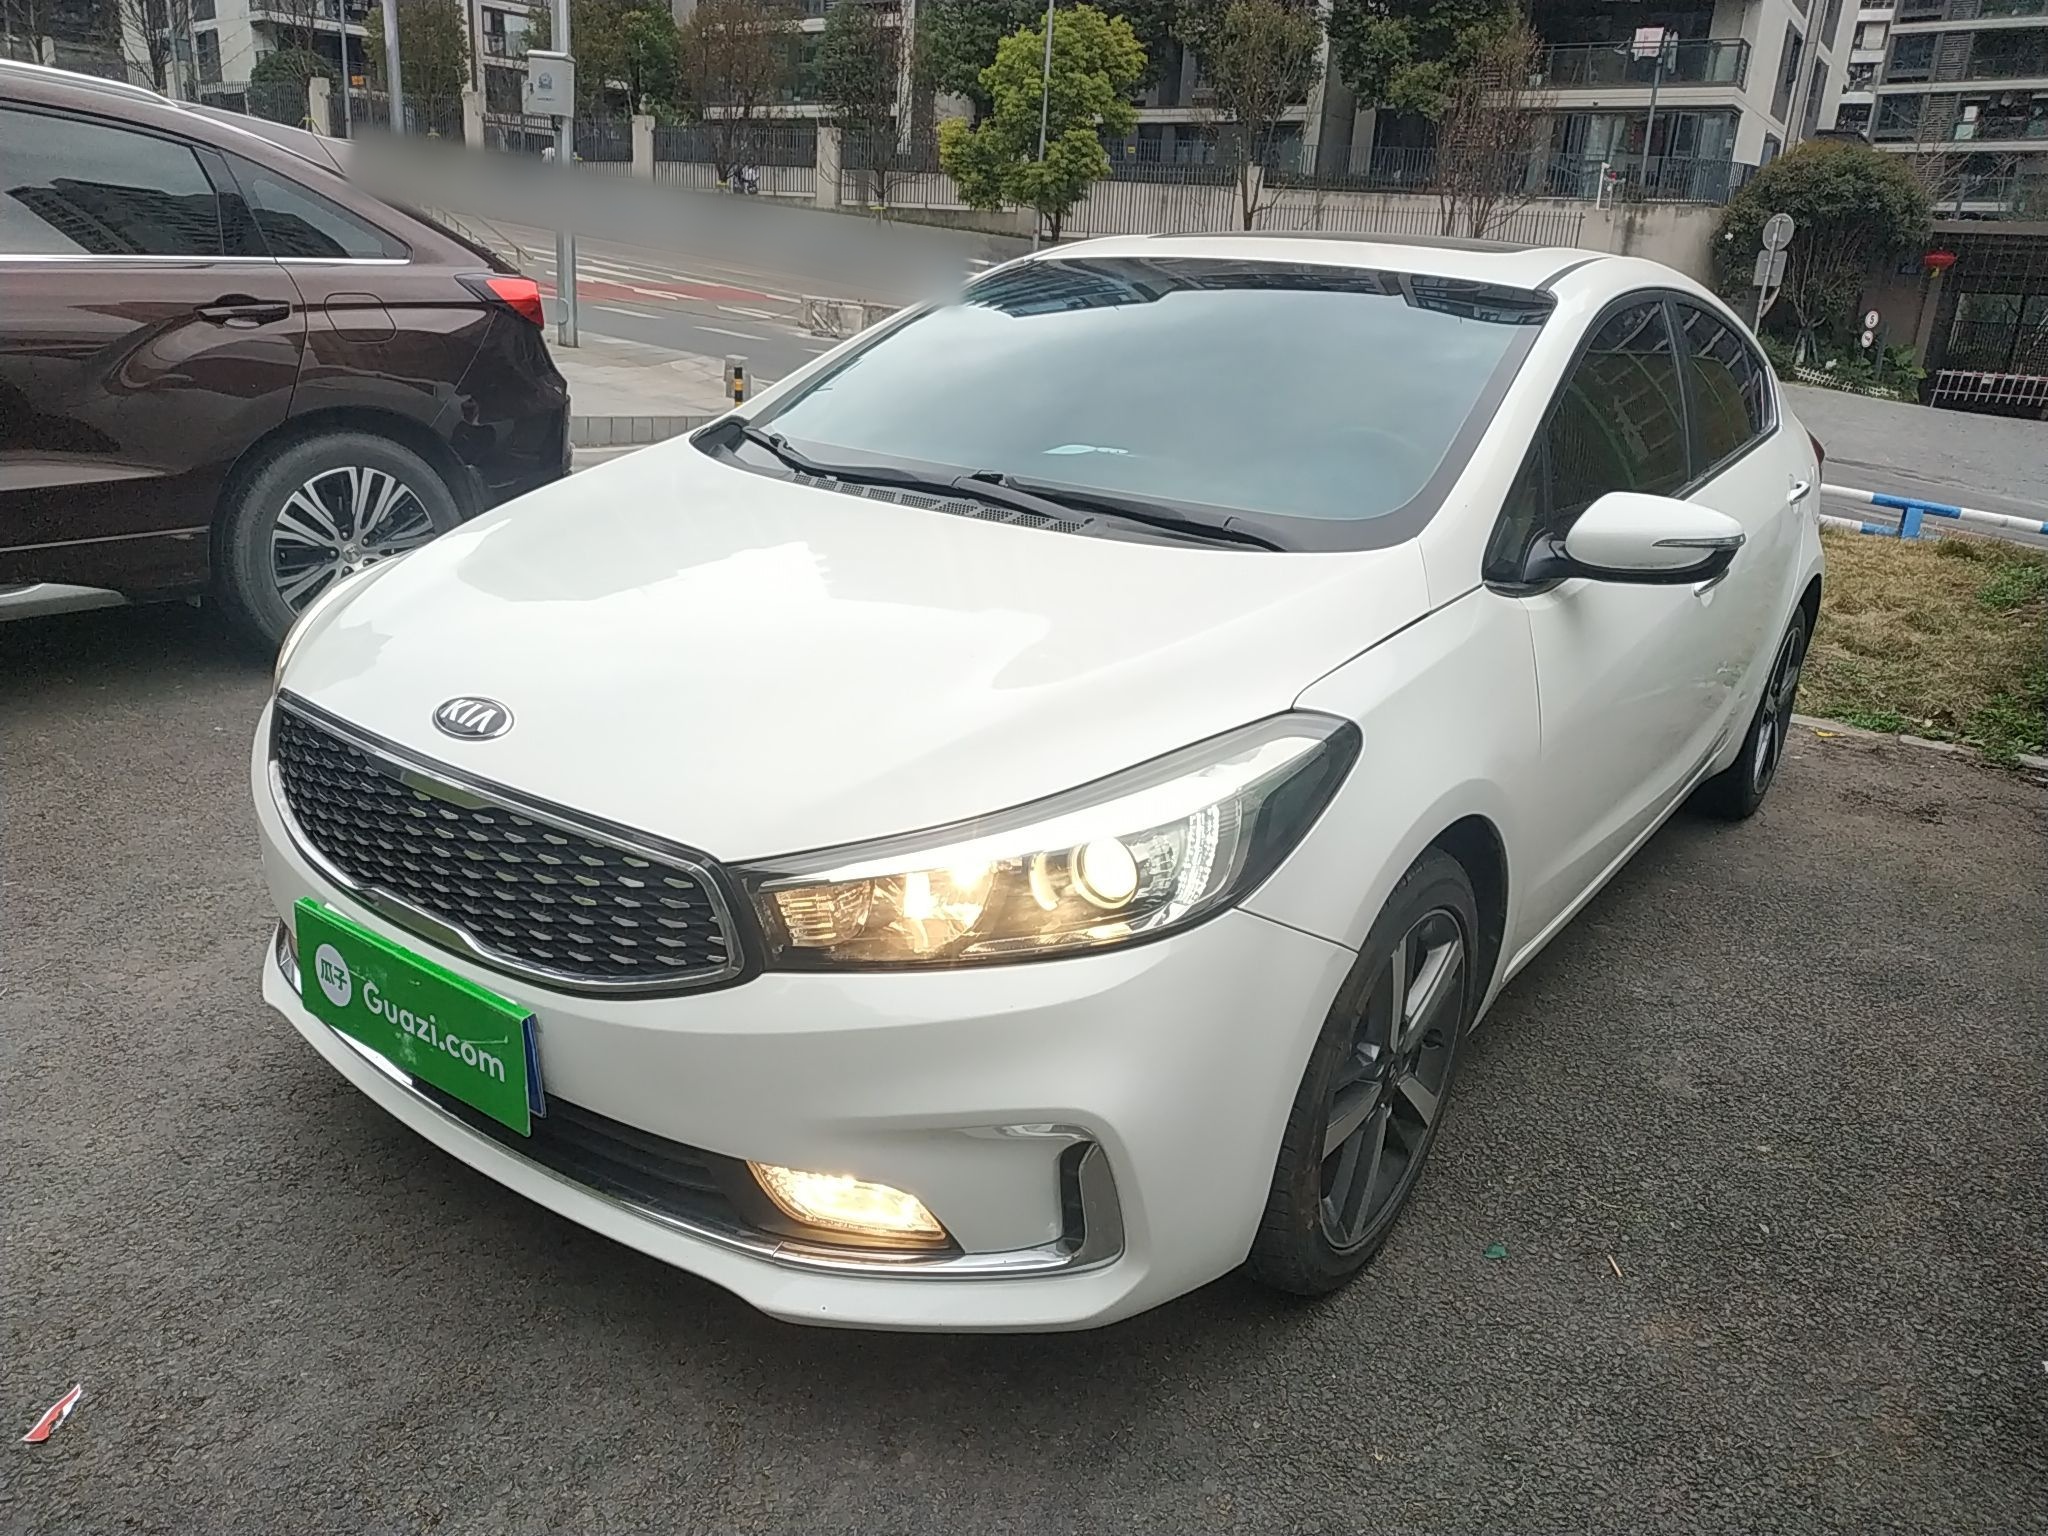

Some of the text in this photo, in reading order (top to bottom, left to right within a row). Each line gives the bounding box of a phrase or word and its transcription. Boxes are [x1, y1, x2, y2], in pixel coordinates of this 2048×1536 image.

[440, 699, 498, 734] KIA
[320, 957, 348, 991] 瓜子
[363, 982, 505, 1083] Guazi.com
